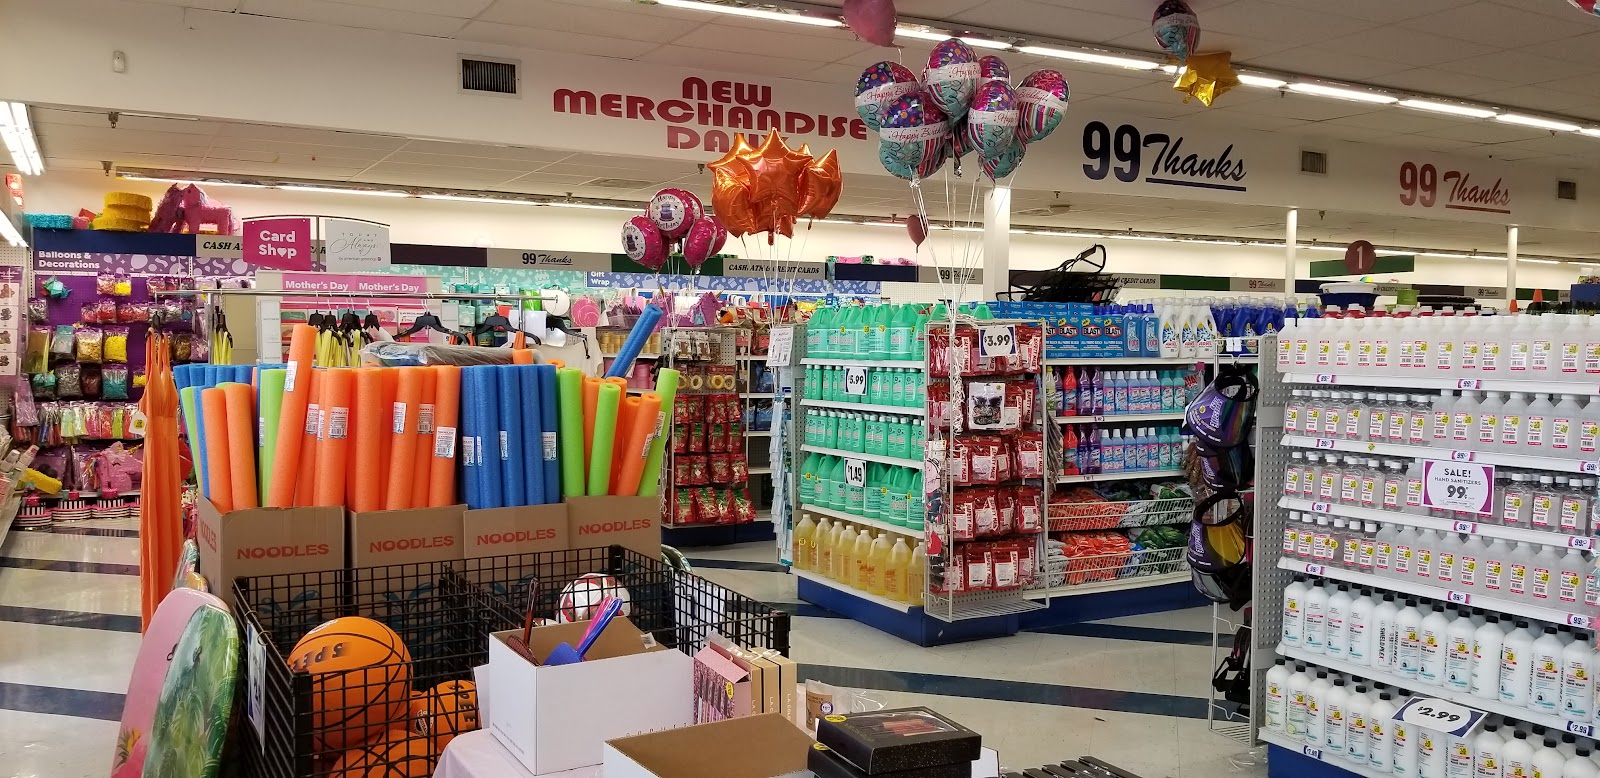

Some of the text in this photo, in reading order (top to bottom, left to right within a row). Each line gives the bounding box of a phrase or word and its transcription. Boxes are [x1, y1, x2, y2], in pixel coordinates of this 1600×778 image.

[681, 76, 772, 108] NEW
[867, 87, 893, 103] Happy
[553, 88, 868, 141] MERCHANDISE
[889, 128, 921, 143] Happy
[1082, 120, 1247, 182] 99 Thanks
[1400, 161, 1511, 208] 99 Thanks
[259, 230, 296, 243] Card
[203, 241, 231, 251] CASH
[330, 237, 377, 256] Always
[38, 250, 92, 260] Balloons &
[521, 252, 573, 265] 99 Thanks
[1356, 246, 1364, 270] 1
[38, 260, 100, 269] Decorations
[590, 277, 610, 287] Wrap
[940, 269, 951, 280] 99
[285, 280, 349, 292] Mother's Day
[358, 282, 420, 294] Mother's Day
[1248, 280, 1276, 289] 99 Thanks
[984, 334, 1011, 347] $3.99
[848, 464, 862, 482] $1.49
[1444, 468, 1472, 478] SALE!
[1450, 478, 1482, 486] SANITIZERS
[578, 518, 651, 536] NOODLES
[369, 536, 454, 552] NOODLES
[476, 528, 556, 546] NOODLES
[236, 543, 329, 560] NOODLES
[1418, 706, 1460, 722] $2.99
